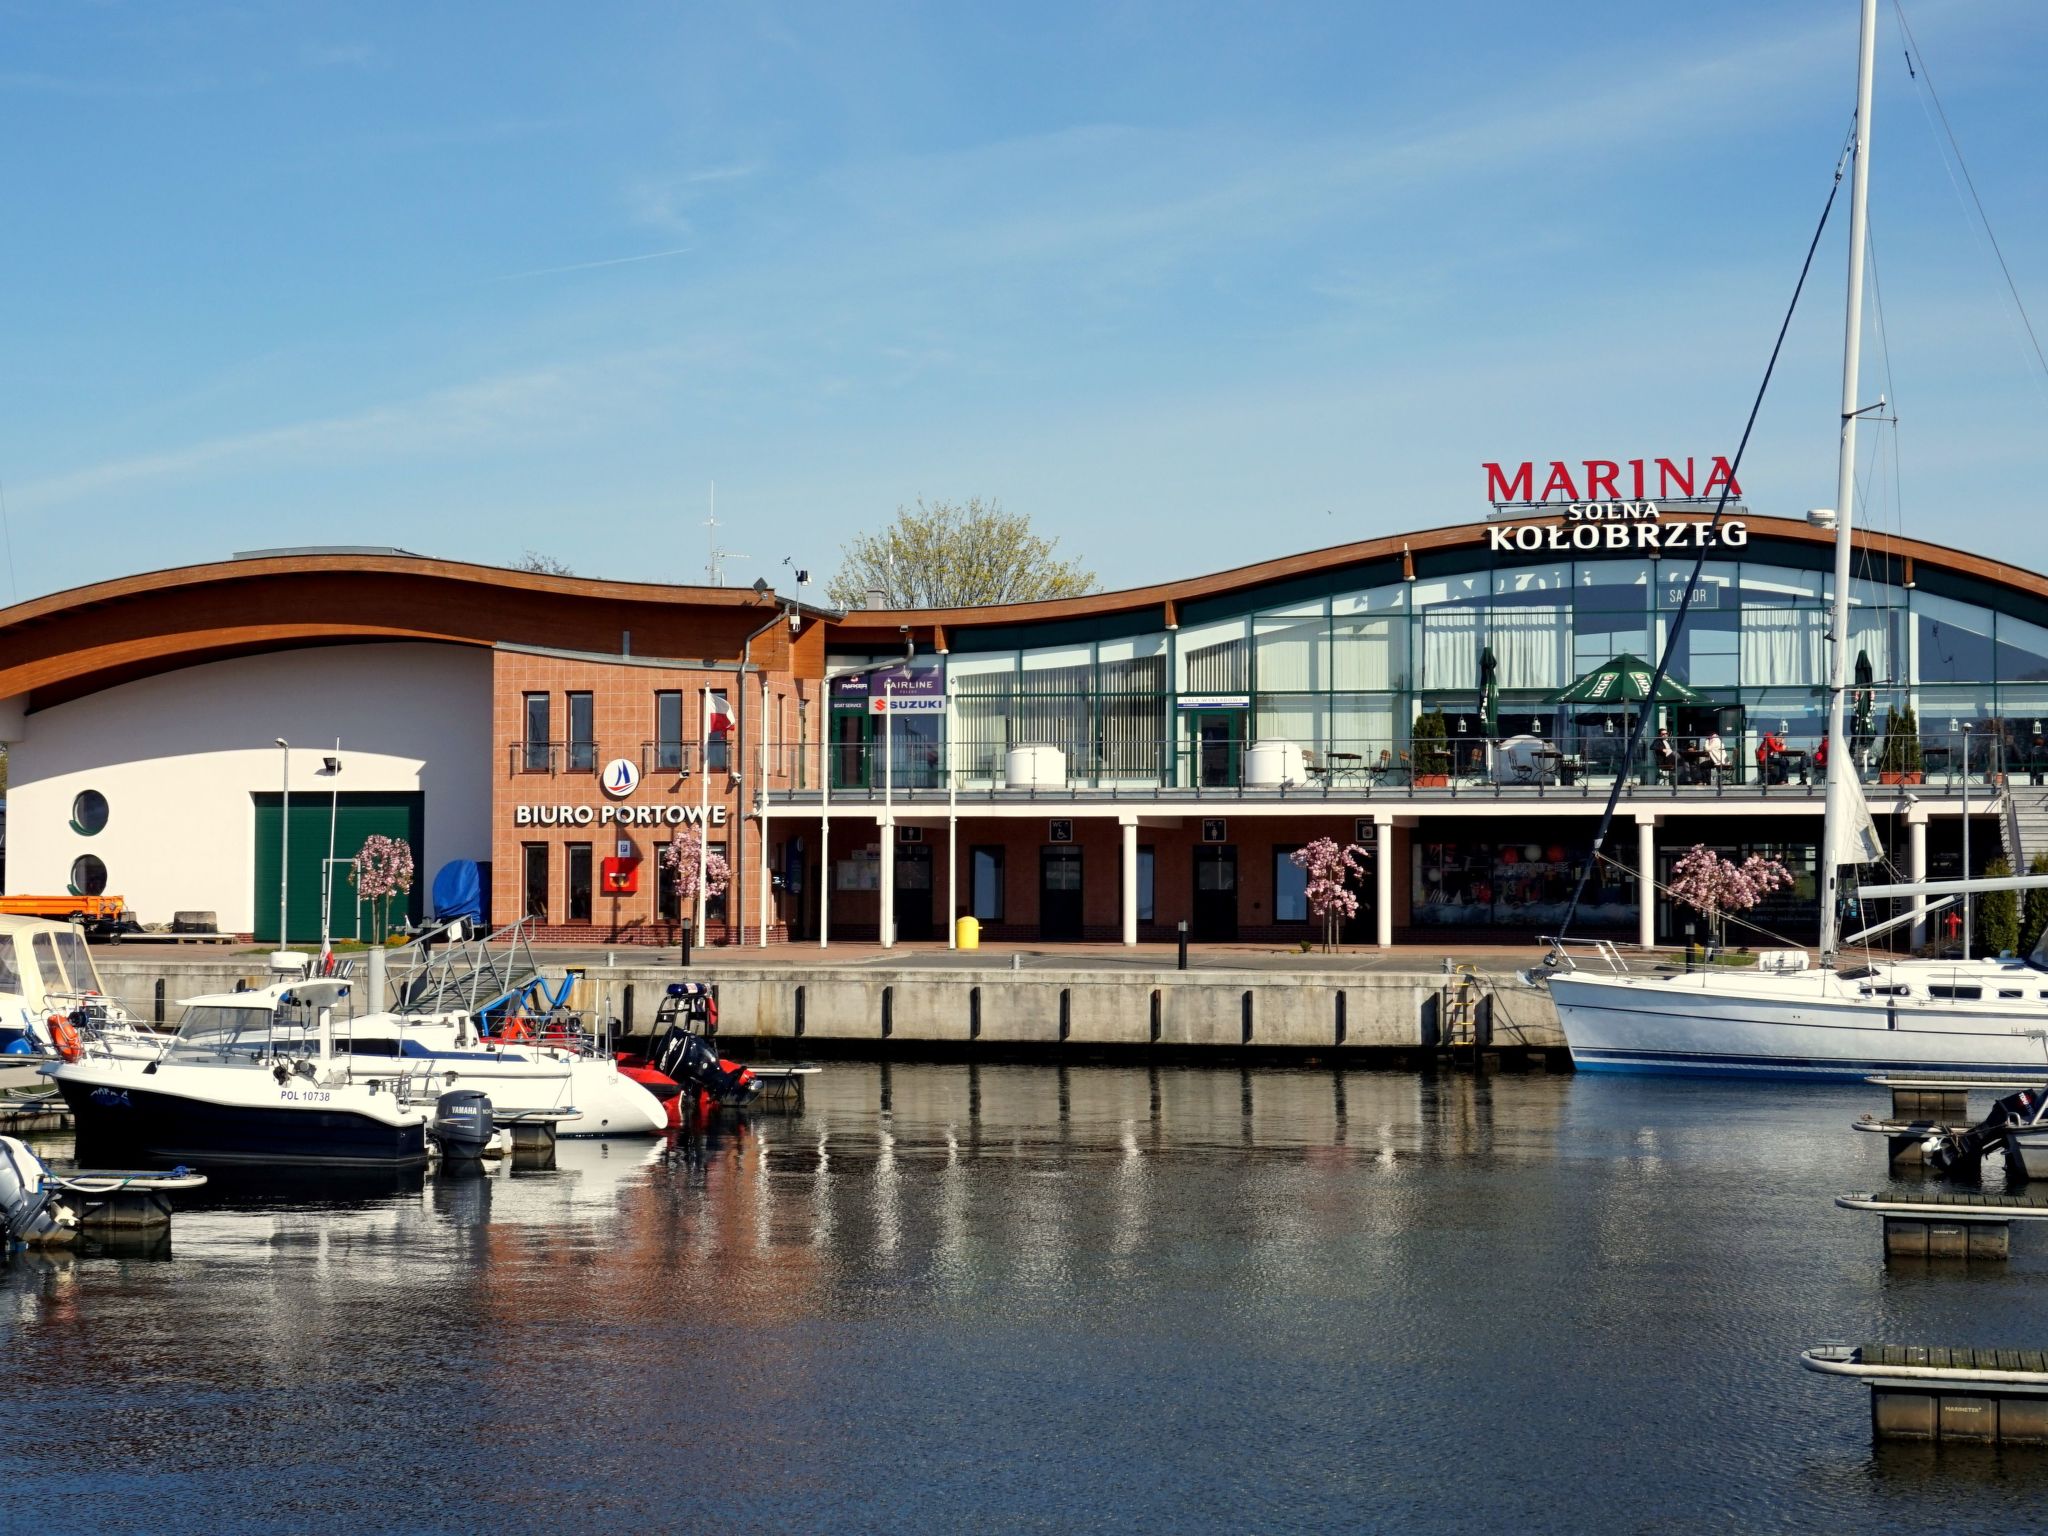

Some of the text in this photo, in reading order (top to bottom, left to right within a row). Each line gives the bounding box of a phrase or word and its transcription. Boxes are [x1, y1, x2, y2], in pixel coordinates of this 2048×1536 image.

[1482, 456, 1743, 501] MARINA
[1568, 501, 1660, 521] SOLNA
[1487, 521, 1747, 550] KOŁOBRZEG
[1670, 589, 1707, 602] SAOR
[1591, 680, 1611, 697] LECH
[890, 701, 942, 709] SUZUKI
[516, 805, 726, 824] BIURO PORTOWE
[281, 1091, 330, 1102] POL 10738
[452, 1105, 478, 1115] YAMAHA
